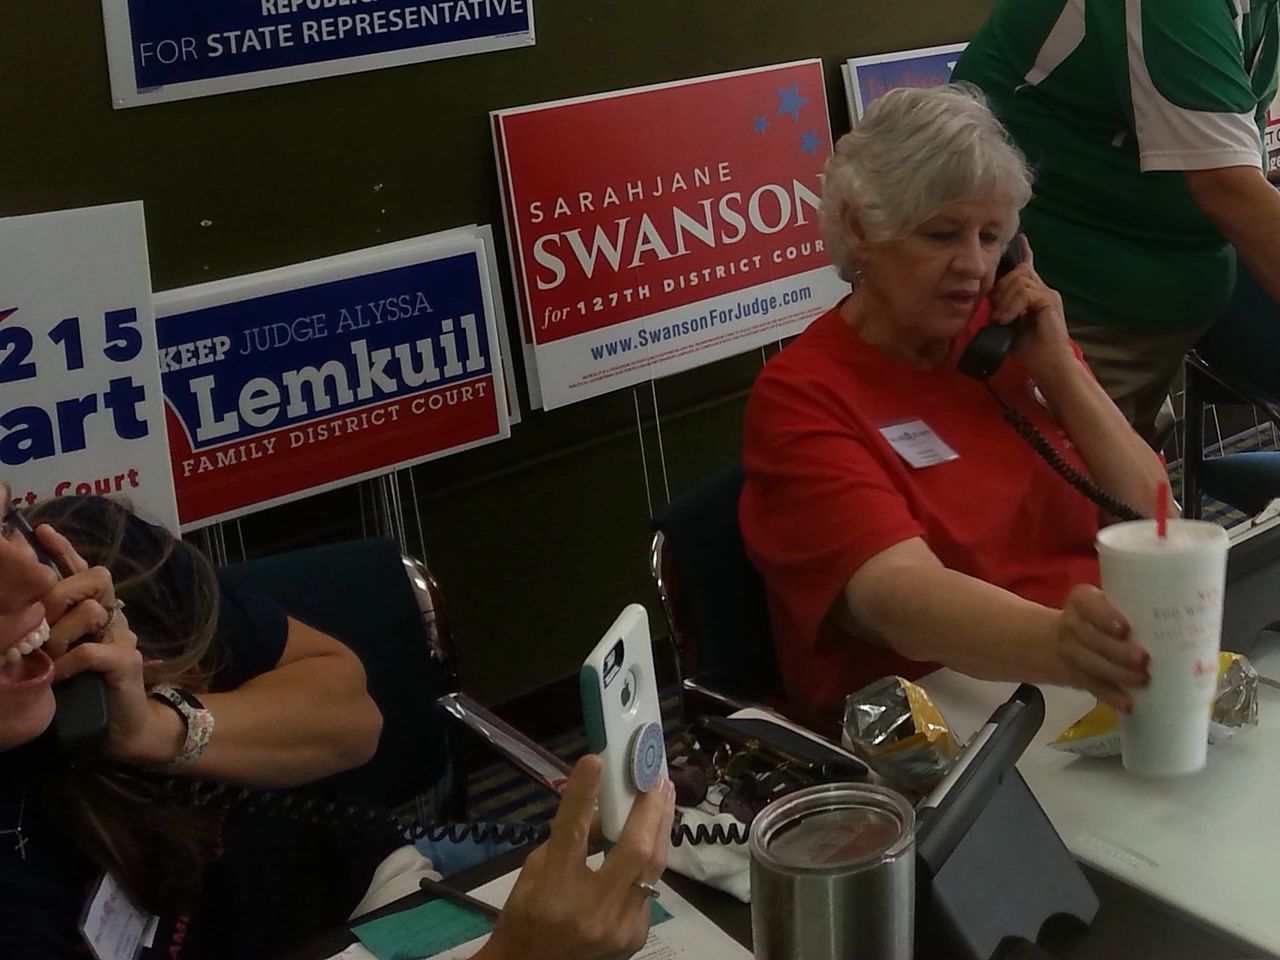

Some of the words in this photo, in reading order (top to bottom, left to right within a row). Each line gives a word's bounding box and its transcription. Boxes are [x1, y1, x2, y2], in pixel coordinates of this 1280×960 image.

[139, 37, 199, 67] FOR
[205, 24, 294, 58] STATE
[529, 161, 733, 224] SARAHJANE
[541, 305, 570, 329] for
[576, 283, 652, 316] 127TH
[663, 255, 762, 292] DISTRICT
[773, 239, 825, 264] COUR
[591, 283, 812, 361] www.SwansonForJudge.com
[158, 334, 232, 373] KEEP
[239, 313, 329, 355] JUDGE
[335, 291, 434, 334] ALYSSA
[190, 313, 486, 437] Lemkuil
[182, 437, 277, 477] FAMILY
[290, 405, 400, 449] DISTRICT
[411, 381, 488, 415] COURT
